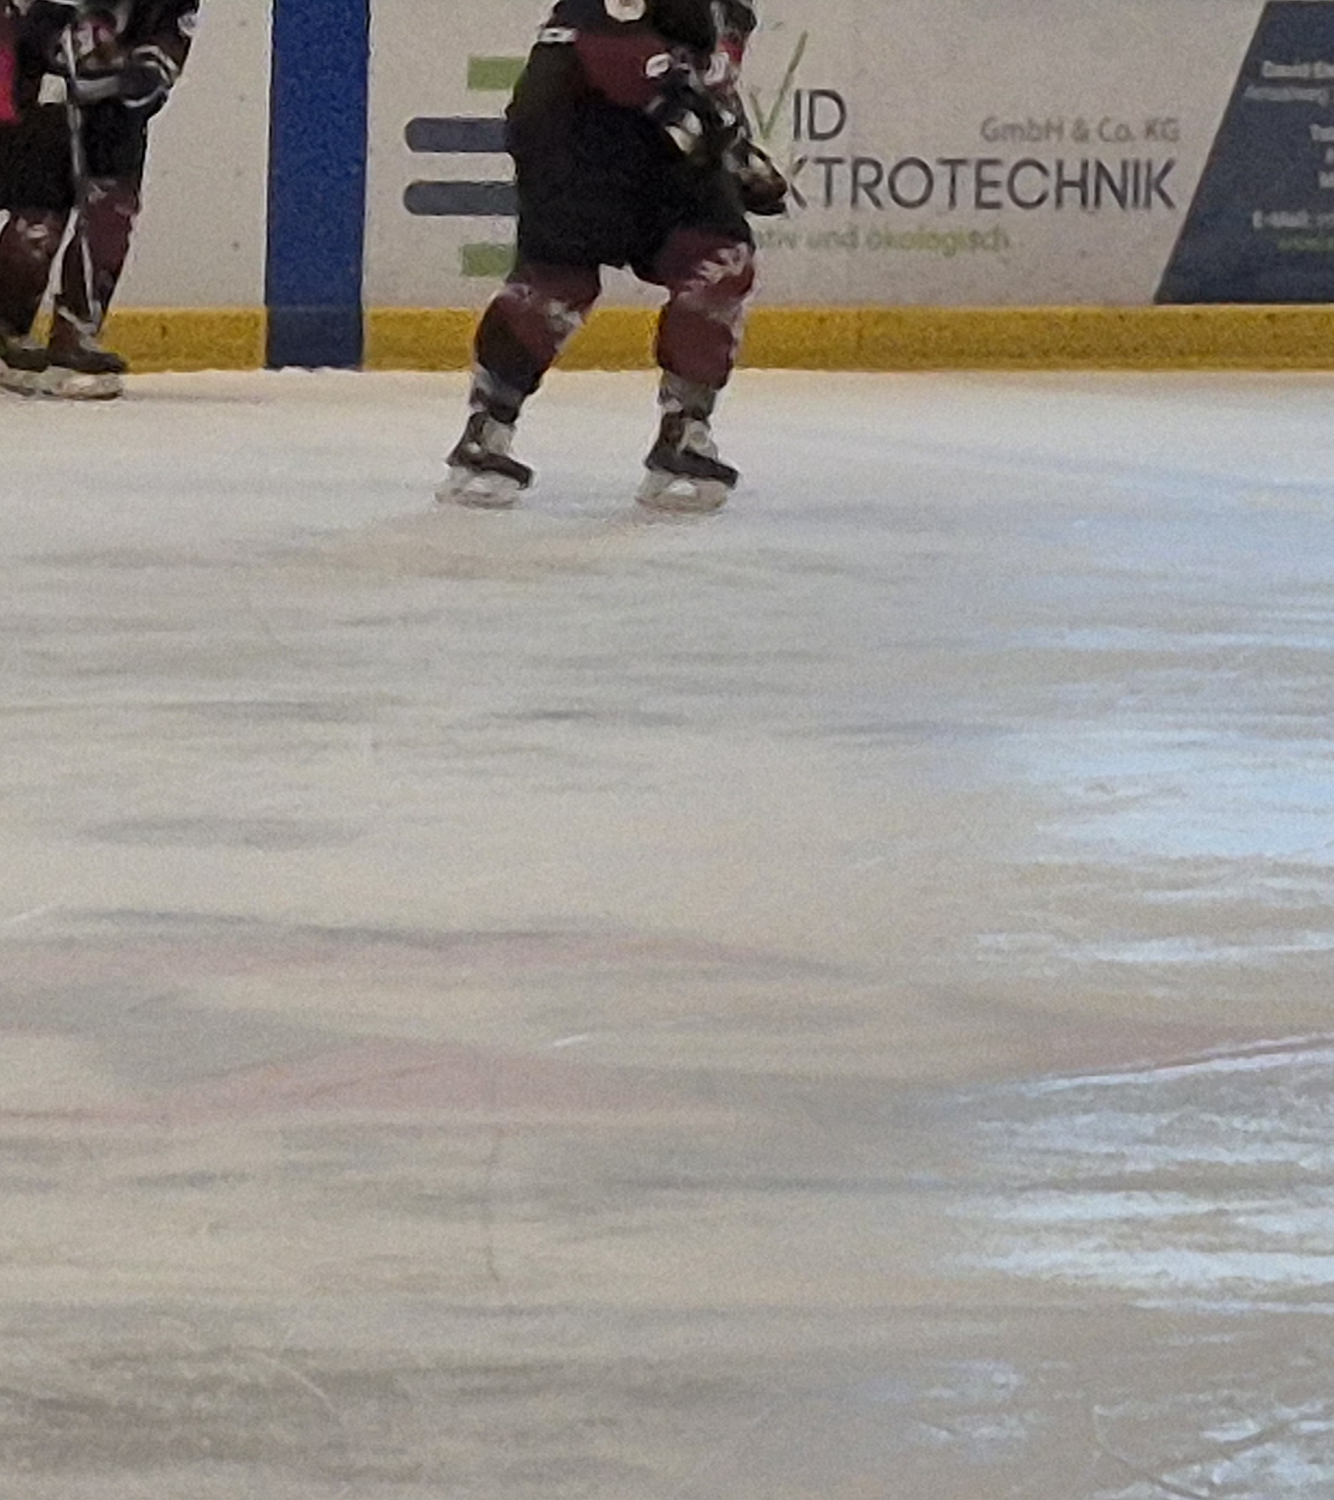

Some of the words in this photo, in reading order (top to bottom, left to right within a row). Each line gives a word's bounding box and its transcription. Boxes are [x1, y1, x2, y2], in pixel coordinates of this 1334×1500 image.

[979, 116, 1063, 143] GmbH
[1070, 117, 1091, 142] &
[1096, 117, 1136, 143] Co.
[1143, 118, 1182, 143] KG
[786, 155, 1177, 211] KTROTECHNIK
